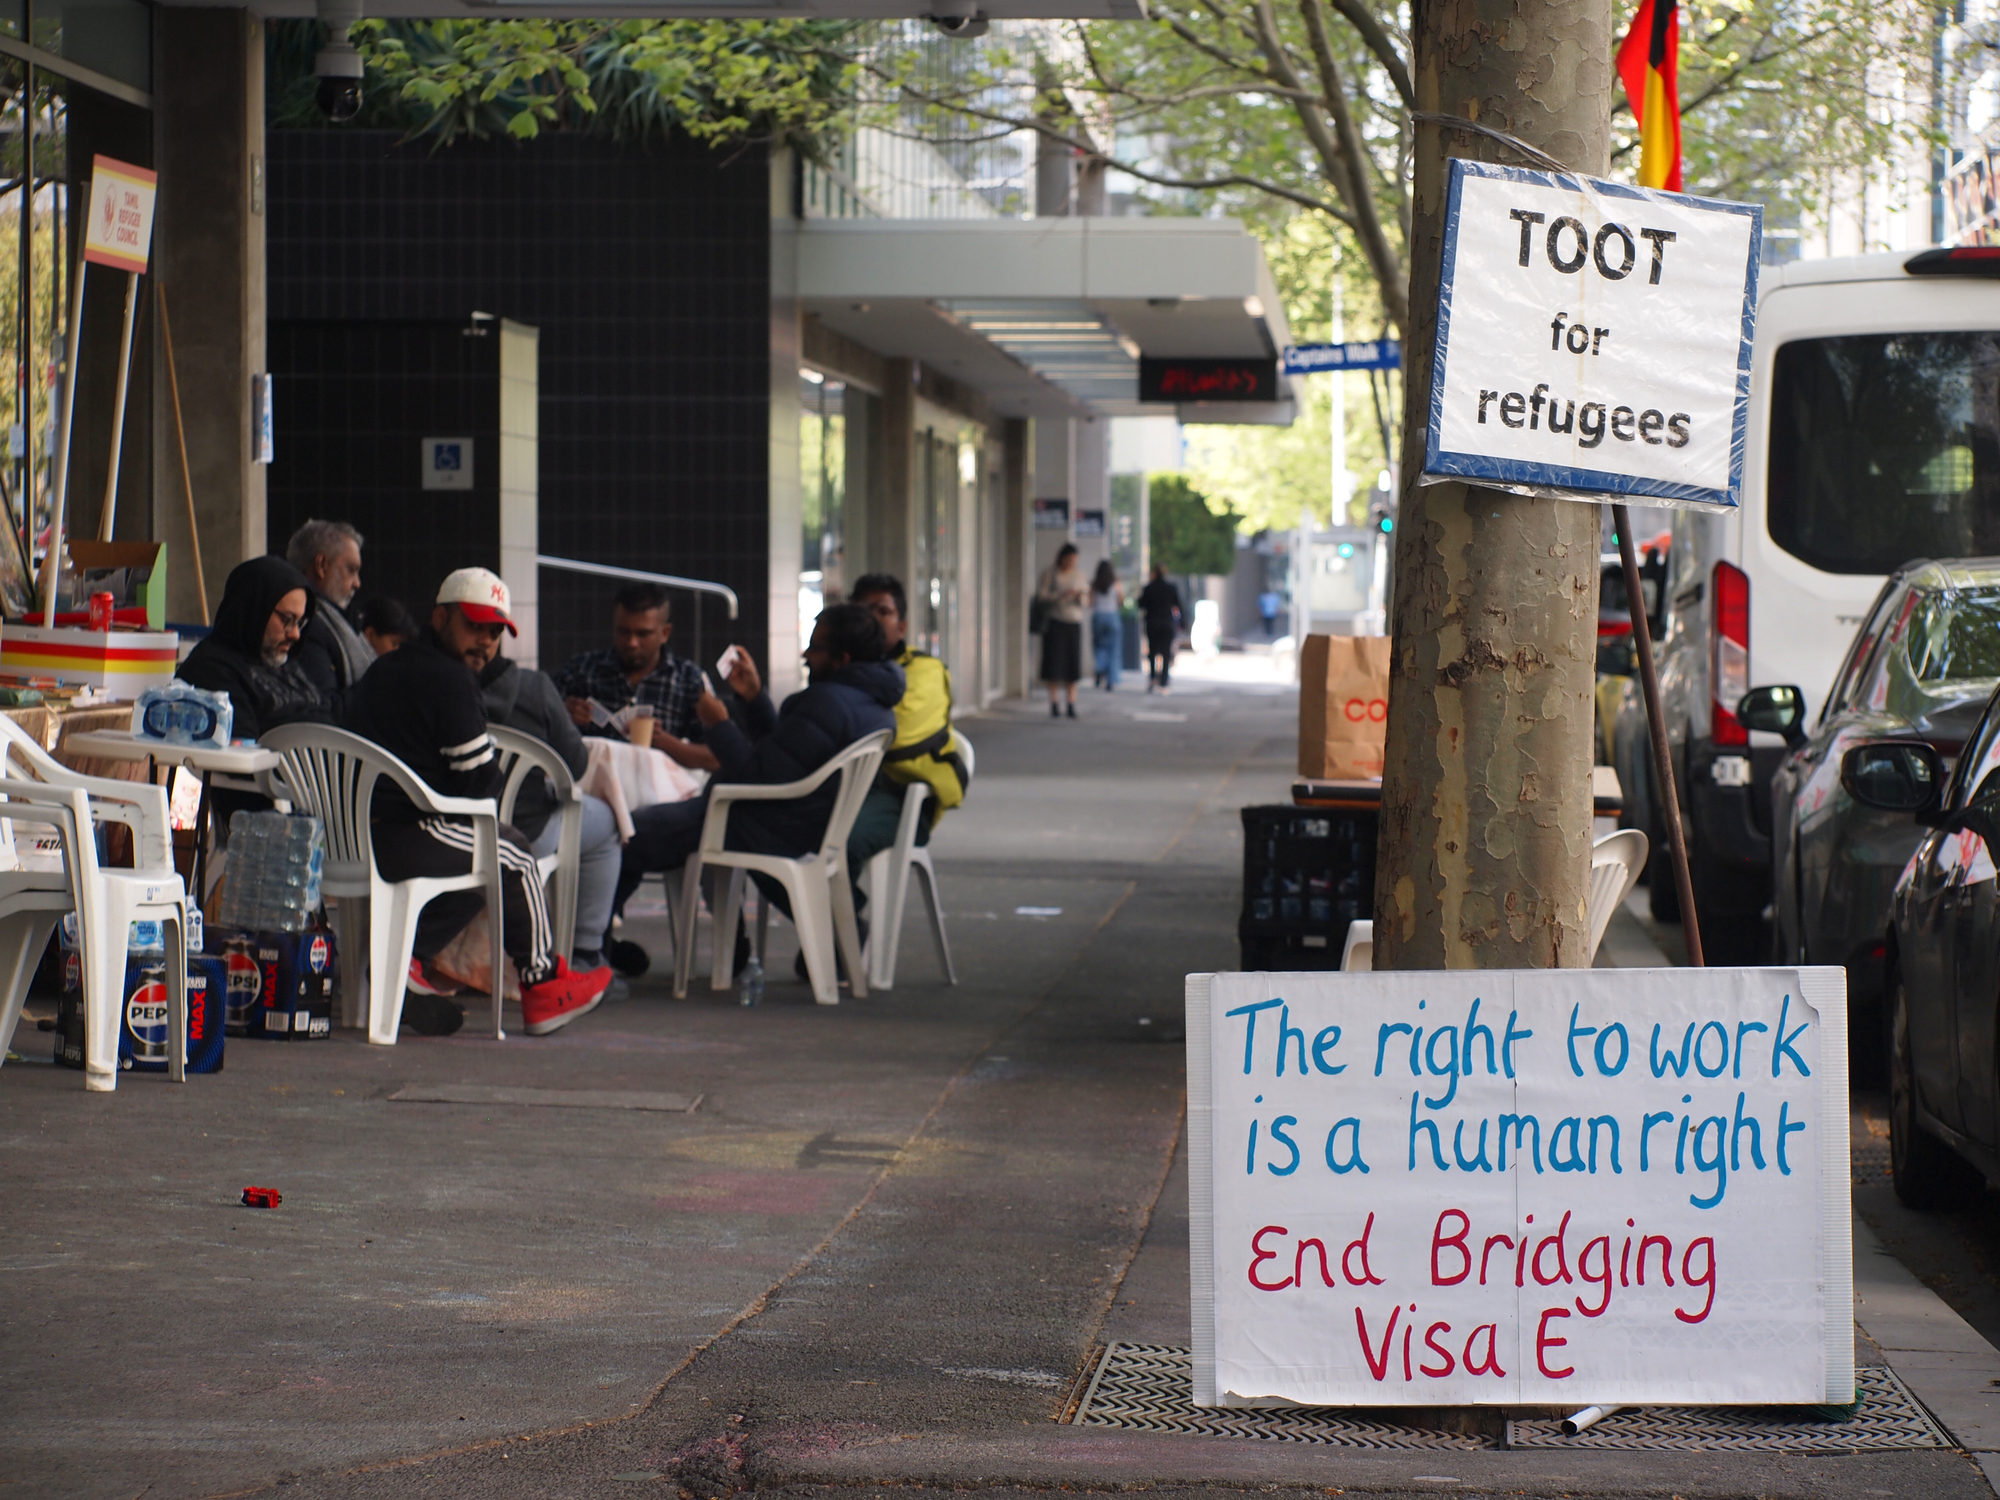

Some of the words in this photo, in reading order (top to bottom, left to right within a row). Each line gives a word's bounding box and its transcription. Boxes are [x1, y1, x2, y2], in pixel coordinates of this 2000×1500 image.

[1509, 208, 1677, 286] TOOT
[1286, 346, 1344, 370] Captains
[1550, 312, 1610, 356] for
[1476, 383, 1692, 449] refugees
[190, 990, 207, 1040] MAX
[263, 962, 279, 1008] MAX
[1226, 997, 1348, 1077] The
[1375, 997, 1533, 1110] right
[1566, 1002, 1629, 1078] to
[1650, 994, 1812, 1079] work
[1246, 1094, 1301, 1177] is
[1325, 1116, 1370, 1175] a
[1408, 1090, 1623, 1175] human
[1640, 1091, 1807, 1210] right
[1248, 1211, 1387, 1292] End
[1430, 1207, 1716, 1324] Bridging
[1355, 1303, 1507, 1382] Visa
[1536, 1307, 1575, 1379] E
